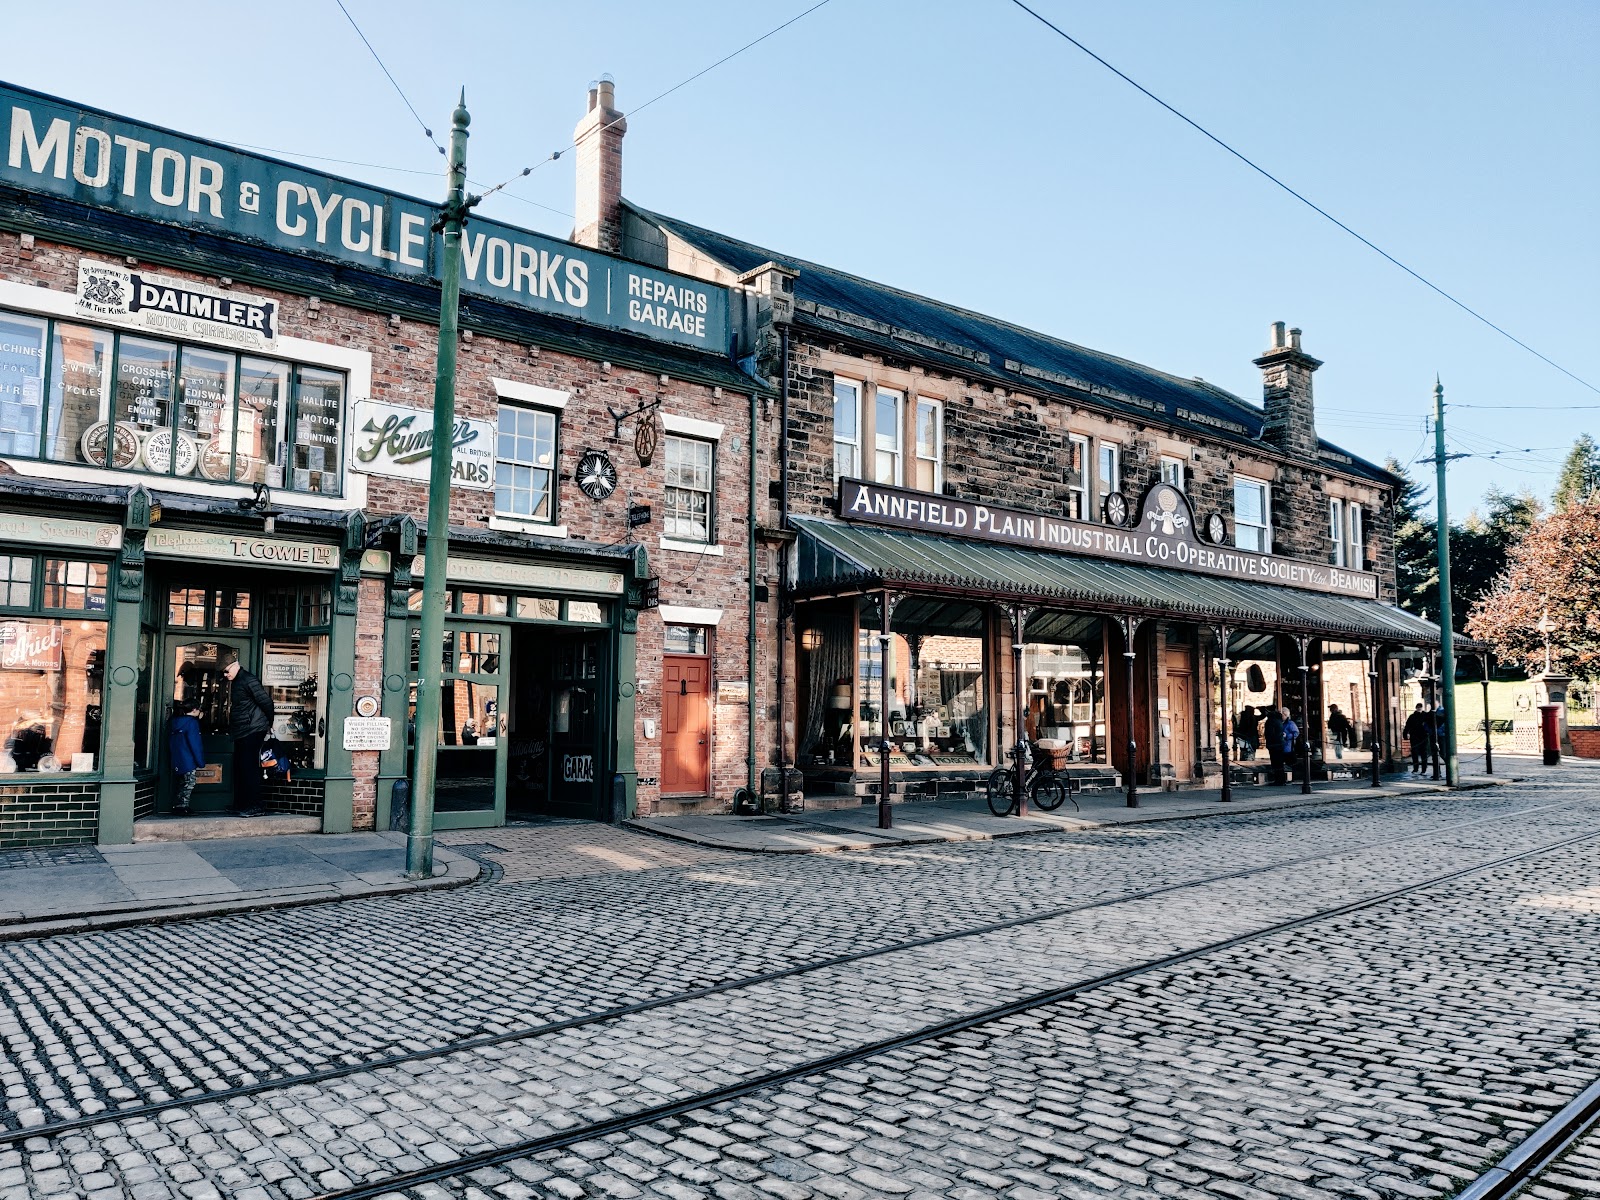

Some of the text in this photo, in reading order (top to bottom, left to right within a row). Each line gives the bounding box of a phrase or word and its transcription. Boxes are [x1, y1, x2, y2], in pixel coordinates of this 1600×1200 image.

[8, 106, 225, 219] MOTOR
[238, 181, 260, 216] &
[276, 180, 426, 268] CYCLE
[90, 267, 122, 279] APPOINTMENT
[628, 273, 708, 315] REPAIRS
[94, 304, 106, 314] THE
[140, 284, 265, 330] DAIMLER
[145, 312, 188, 332] MOTOR
[628, 299, 706, 338] GARAGE
[3, 364, 26, 374] FOR
[121, 364, 173, 380] CROSSLEY
[57, 381, 103, 396] CYCLES
[131, 376, 160, 388] CARS
[191, 378, 224, 390] ROYAL
[139, 388, 152, 396] OF
[184, 387, 228, 402] EDISWAN
[135, 397, 154, 407] GAS
[302, 395, 338, 409] HALLITE
[127, 404, 162, 418] ENGINE
[193, 406, 218, 417] LAMPS
[182, 415, 203, 428] SOLD
[302, 413, 335, 426] MOTOR
[298, 431, 338, 445] JOINTING
[356, 414, 479, 464] Humer
[469, 448, 492, 458] BRITISH
[450, 460, 489, 484] ARS
[39, 521, 92, 541] Specialist
[152, 533, 204, 550] Telephone
[850, 485, 968, 529] ANNFIELD
[973, 505, 1035, 540] PLAIN
[1038, 516, 1143, 557] INDUSTRIAL
[1145, 536, 1257, 576] CO-OPERATIVE
[1260, 556, 1316, 584] SOCIETY
[1329, 568, 1377, 594] BEAMISH
[230, 538, 247, 557] T.
[250, 541, 310, 562] COWIE
[448, 561, 487, 578] OTOR
[490, 564, 545, 583] GARAGE
[560, 569, 603, 588] DEPOT
[4, 626, 61, 667] Ariel
[31, 659, 59, 668] MOTORS
